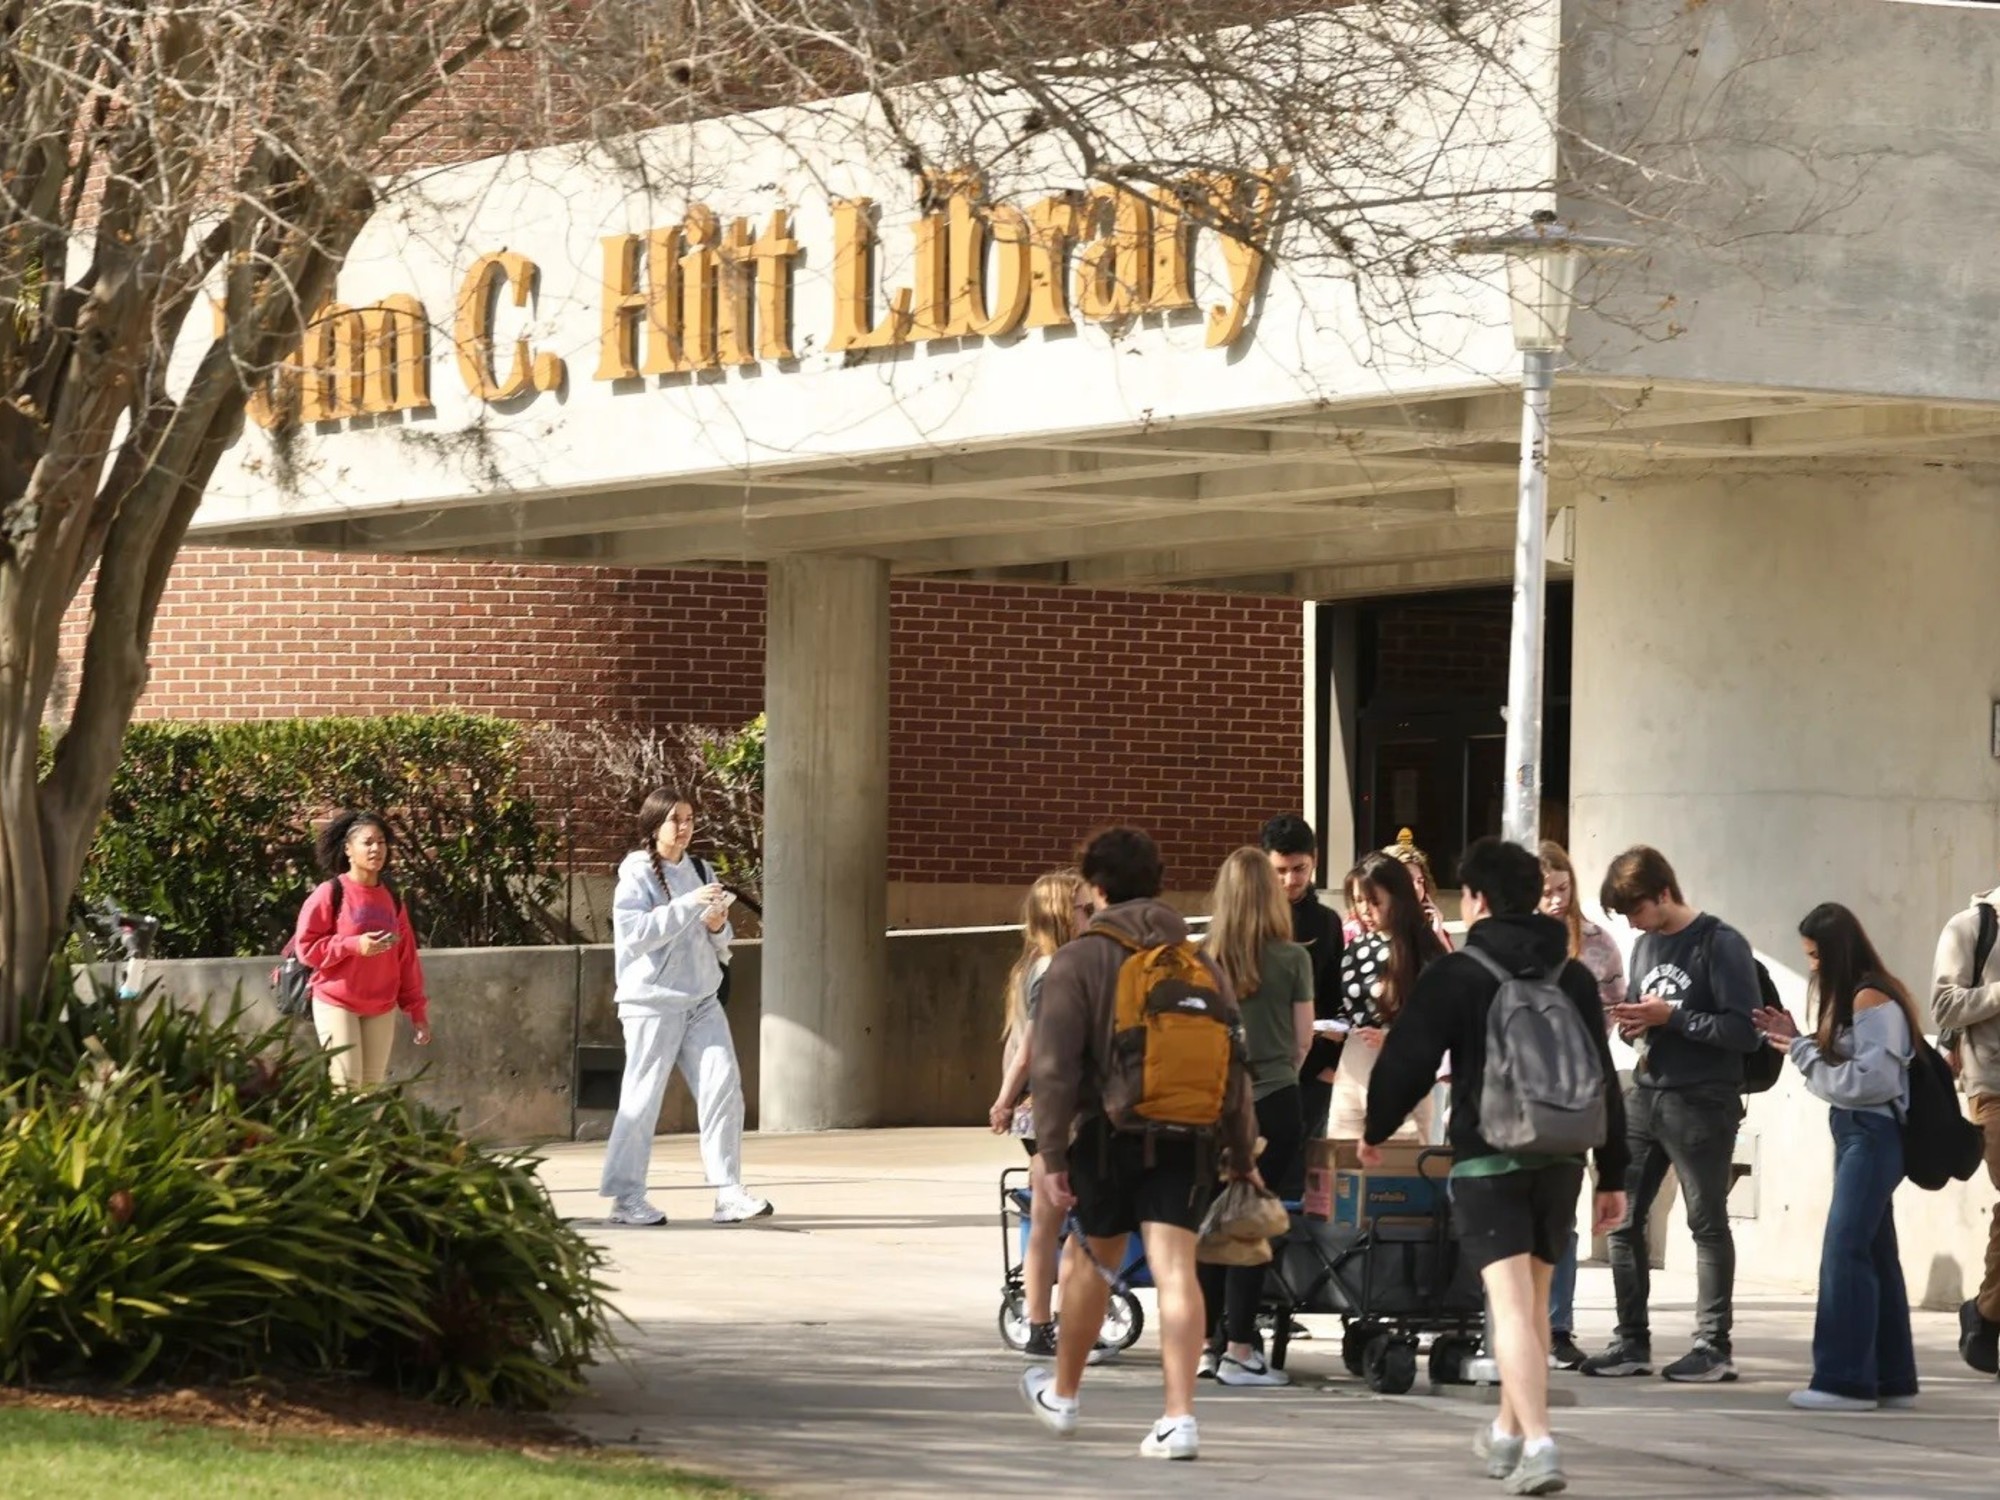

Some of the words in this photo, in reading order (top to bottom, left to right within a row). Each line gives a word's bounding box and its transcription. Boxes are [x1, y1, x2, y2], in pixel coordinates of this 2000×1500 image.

[212, 280, 433, 428] hn
[455, 250, 562, 400] C.
[594, 203, 798, 380] Hitt
[827, 164, 1290, 350] Library
